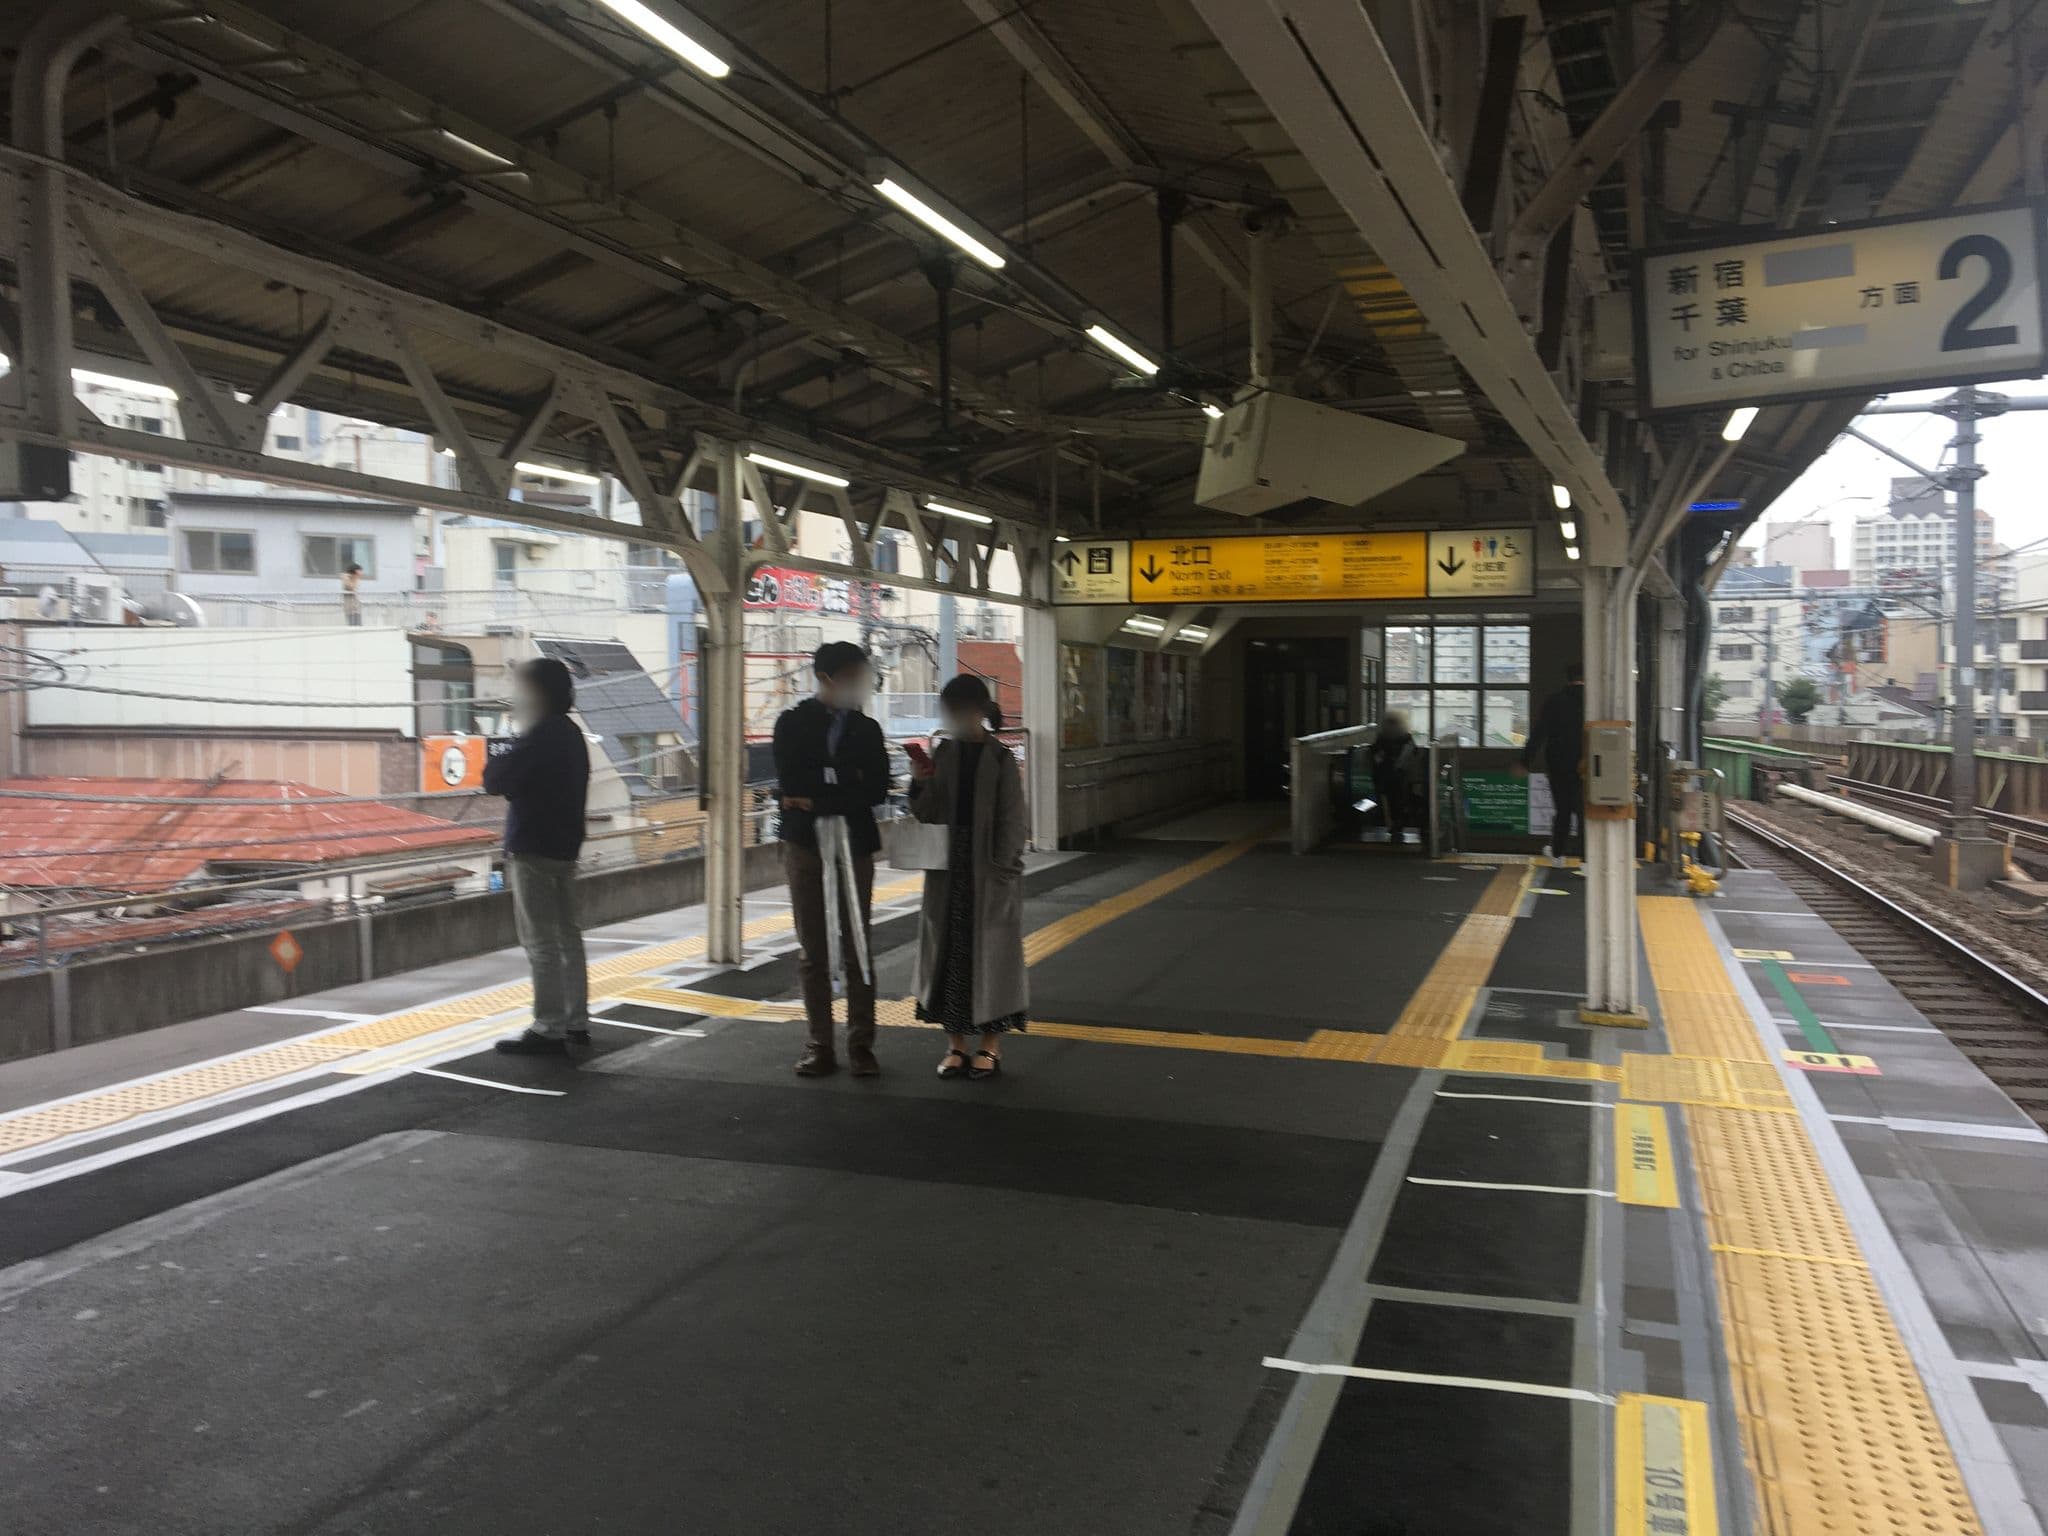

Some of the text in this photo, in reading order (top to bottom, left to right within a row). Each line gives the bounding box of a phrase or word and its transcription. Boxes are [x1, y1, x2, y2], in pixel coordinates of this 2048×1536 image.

[1667, 259, 1746, 296] 新宿
[1937, 234, 2020, 353] 2
[1858, 281, 1921, 310] 方面
[1670, 297, 1749, 332] 千葉
[1673, 345, 1700, 362] for
[1207, 568, 1232, 581] Exit
